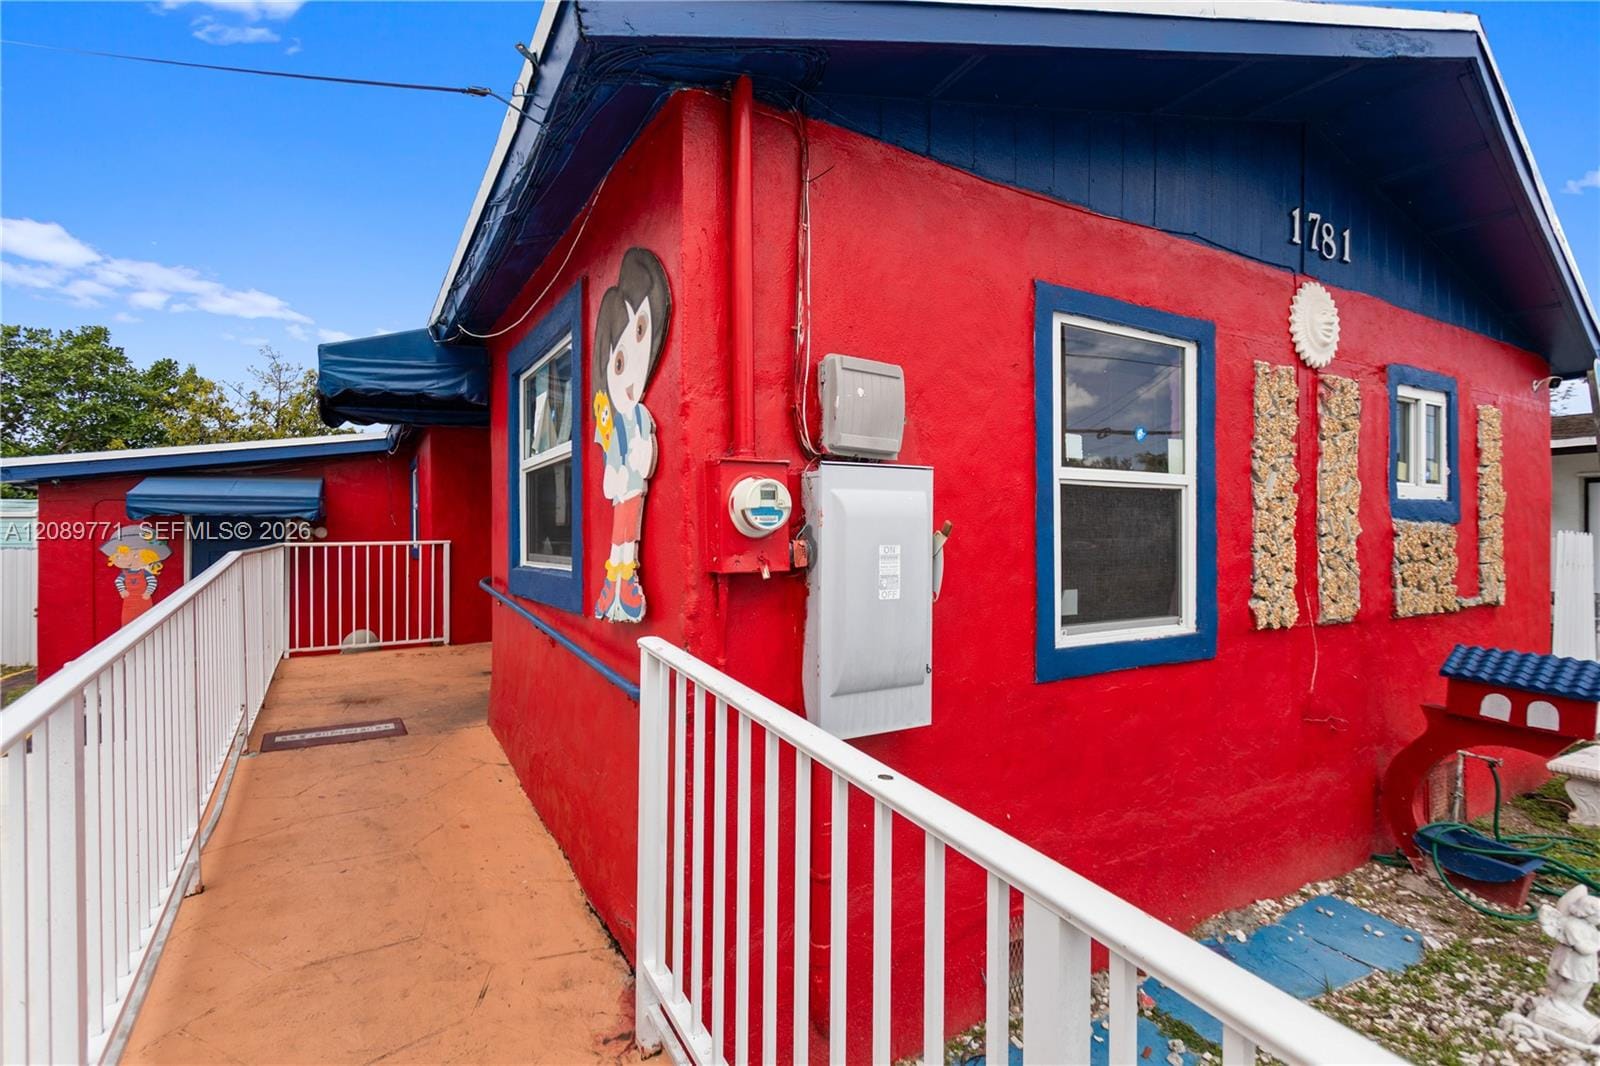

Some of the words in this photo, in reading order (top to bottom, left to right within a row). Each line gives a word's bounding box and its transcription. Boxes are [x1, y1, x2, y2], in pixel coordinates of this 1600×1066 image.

[1292, 207, 1351, 263] 1781
[883, 546, 896, 554] ON
[881, 590, 897, 599] OFF
